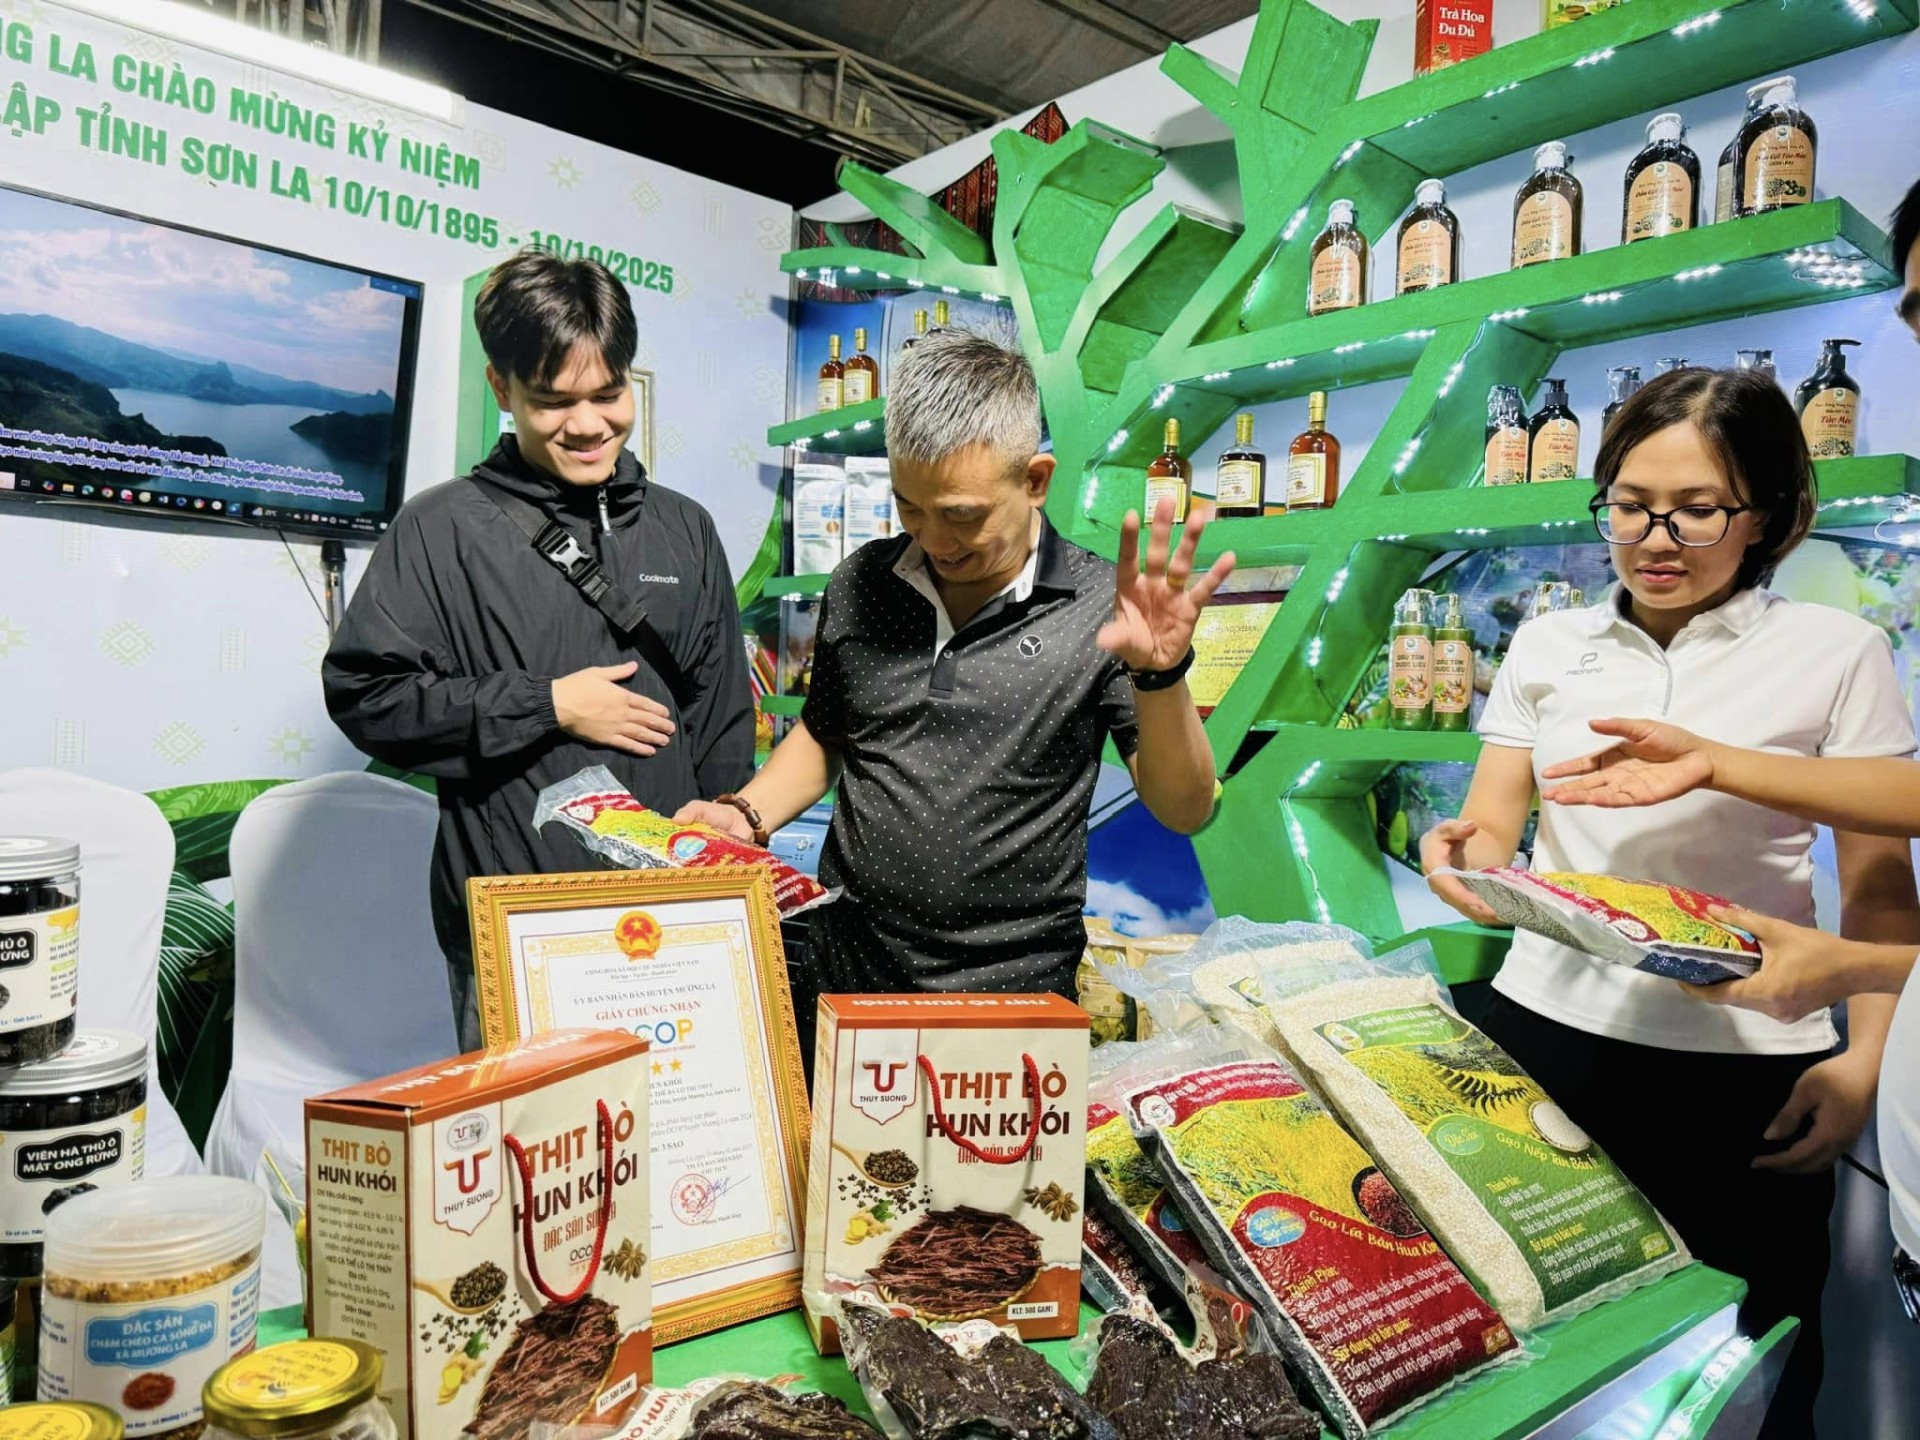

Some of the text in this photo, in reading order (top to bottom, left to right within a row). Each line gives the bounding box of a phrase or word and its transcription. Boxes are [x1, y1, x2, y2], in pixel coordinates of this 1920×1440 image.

[1440, 7, 1485, 23] Trà Hoa
[1439, 23, 1475, 37] Đu Đủ
[0, 17, 480, 190] G LA CHÀO MỪNG KỶ NIỆM
[0, 81, 61, 137] ẬP
[75, 101, 167, 166] TỈNH
[181, 137, 257, 189] SƠN
[271, 160, 311, 203] LA
[325, 177, 498, 249] 10/10/1895
[530, 230, 673, 294] 10/10/2025
[639, 573, 679, 584] Coolmate
[0, 938, 14, 949] Ủ
[615, 1018, 693, 1044] COP
[940, 1063, 1067, 1107] THỊT BÒ
[860, 1094, 907, 1103] THUY SUONG
[926, 1104, 1070, 1138] HUN KHÓI
[60, 1145, 79, 1157] HÀ
[81, 1138, 106, 1154] THỦ
[108, 1137, 116, 1147] Ô
[322, 1138, 391, 1166] THỊT BÒ
[524, 1101, 634, 1179] THỊT BÒ
[667, 1140, 684, 1149] SAO
[1496, 1133, 1521, 1149] Gạo
[1524, 1143, 1548, 1162] Nếp
[1550, 1153, 1570, 1168] Tan
[23, 1148, 118, 1174] MẬT ONG RỪNG
[318, 1165, 396, 1192] HUN KHÓI
[513, 1149, 637, 1234] HUN KHÓI
[444, 1189, 494, 1214] THUY SUONG
[1309, 1210, 1337, 1229] Gạo
[1395, 1241, 1420, 1257] Hua
[570, 1245, 595, 1262] OCO
[155, 1315, 183, 1332] SẢN
[1024, 1306, 1036, 1315] 500
[175, 1341, 188, 1351] LA
[642, 1390, 675, 1426] HUN
